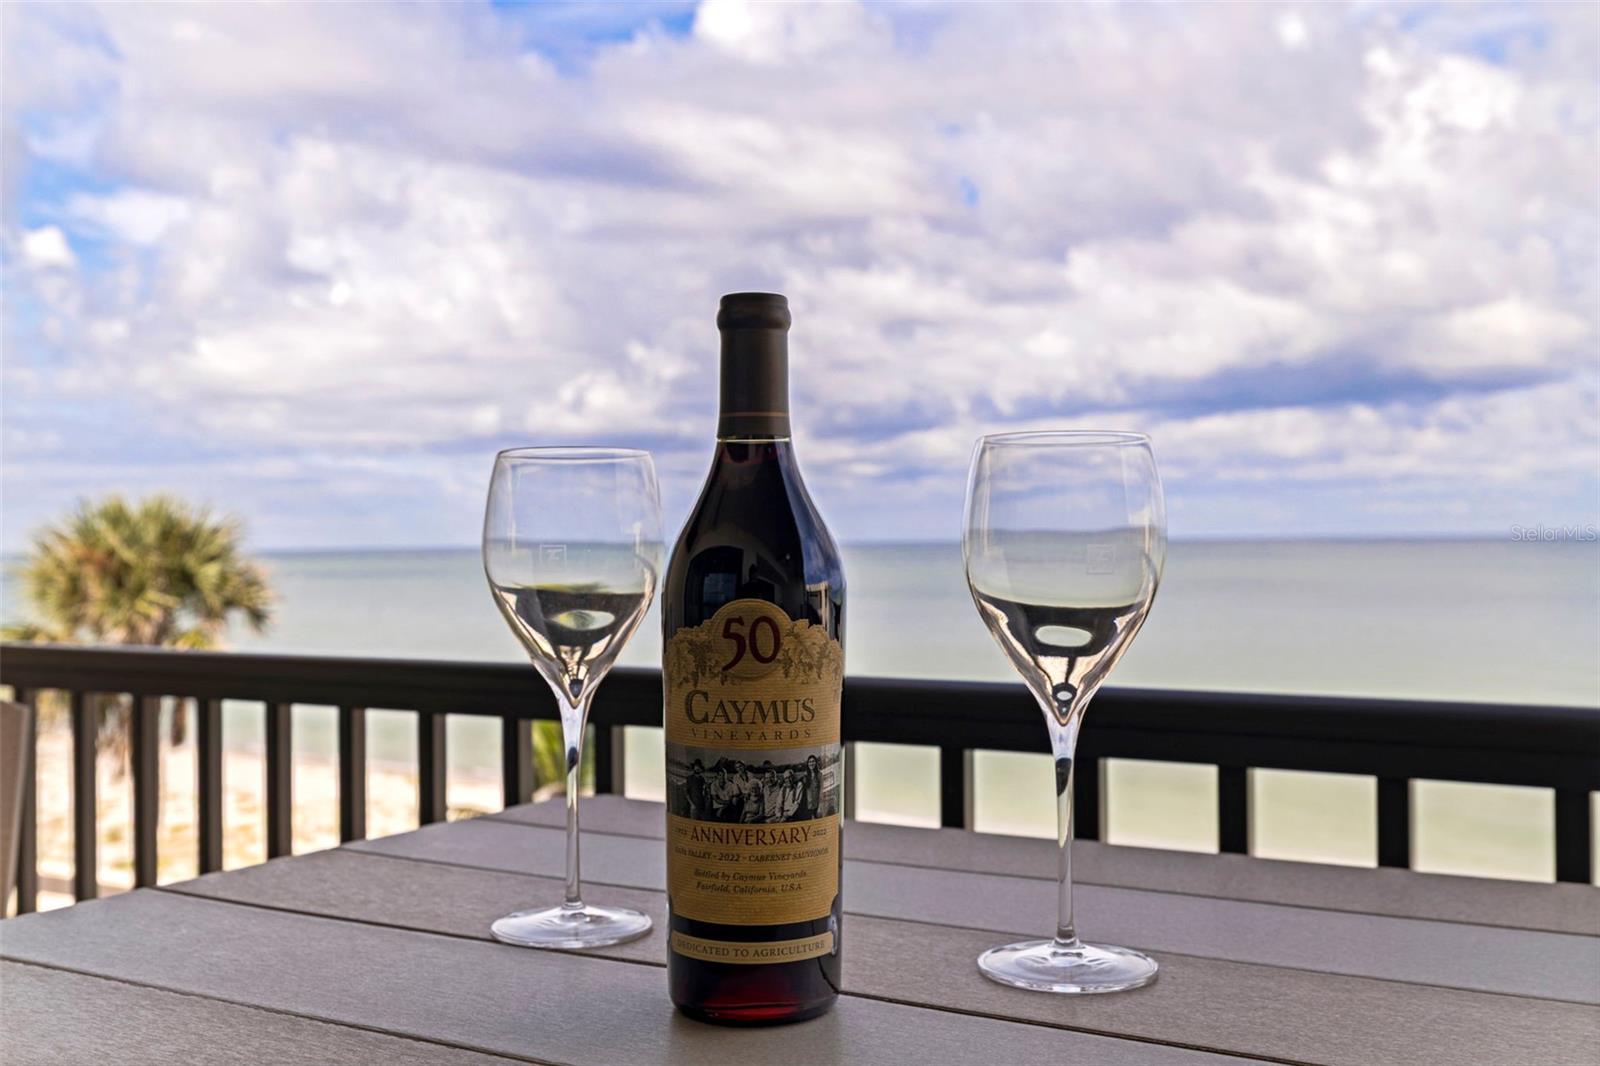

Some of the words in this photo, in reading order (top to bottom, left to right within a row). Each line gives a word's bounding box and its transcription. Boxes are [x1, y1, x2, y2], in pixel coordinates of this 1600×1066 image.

[721, 615, 781, 672] 50
[685, 689, 816, 725] CAYMUS
[691, 728, 812, 741] VINEYARDS
[690, 825, 812, 846] ANNIVERSARY
[718, 852, 740, 862] 2022
[748, 853, 792, 863] CABERNET
[721, 871, 731, 881] by
[677, 938, 730, 958] DEDICATED
[734, 949, 750, 958] TO
[750, 939, 825, 958] AGRICULTURE
